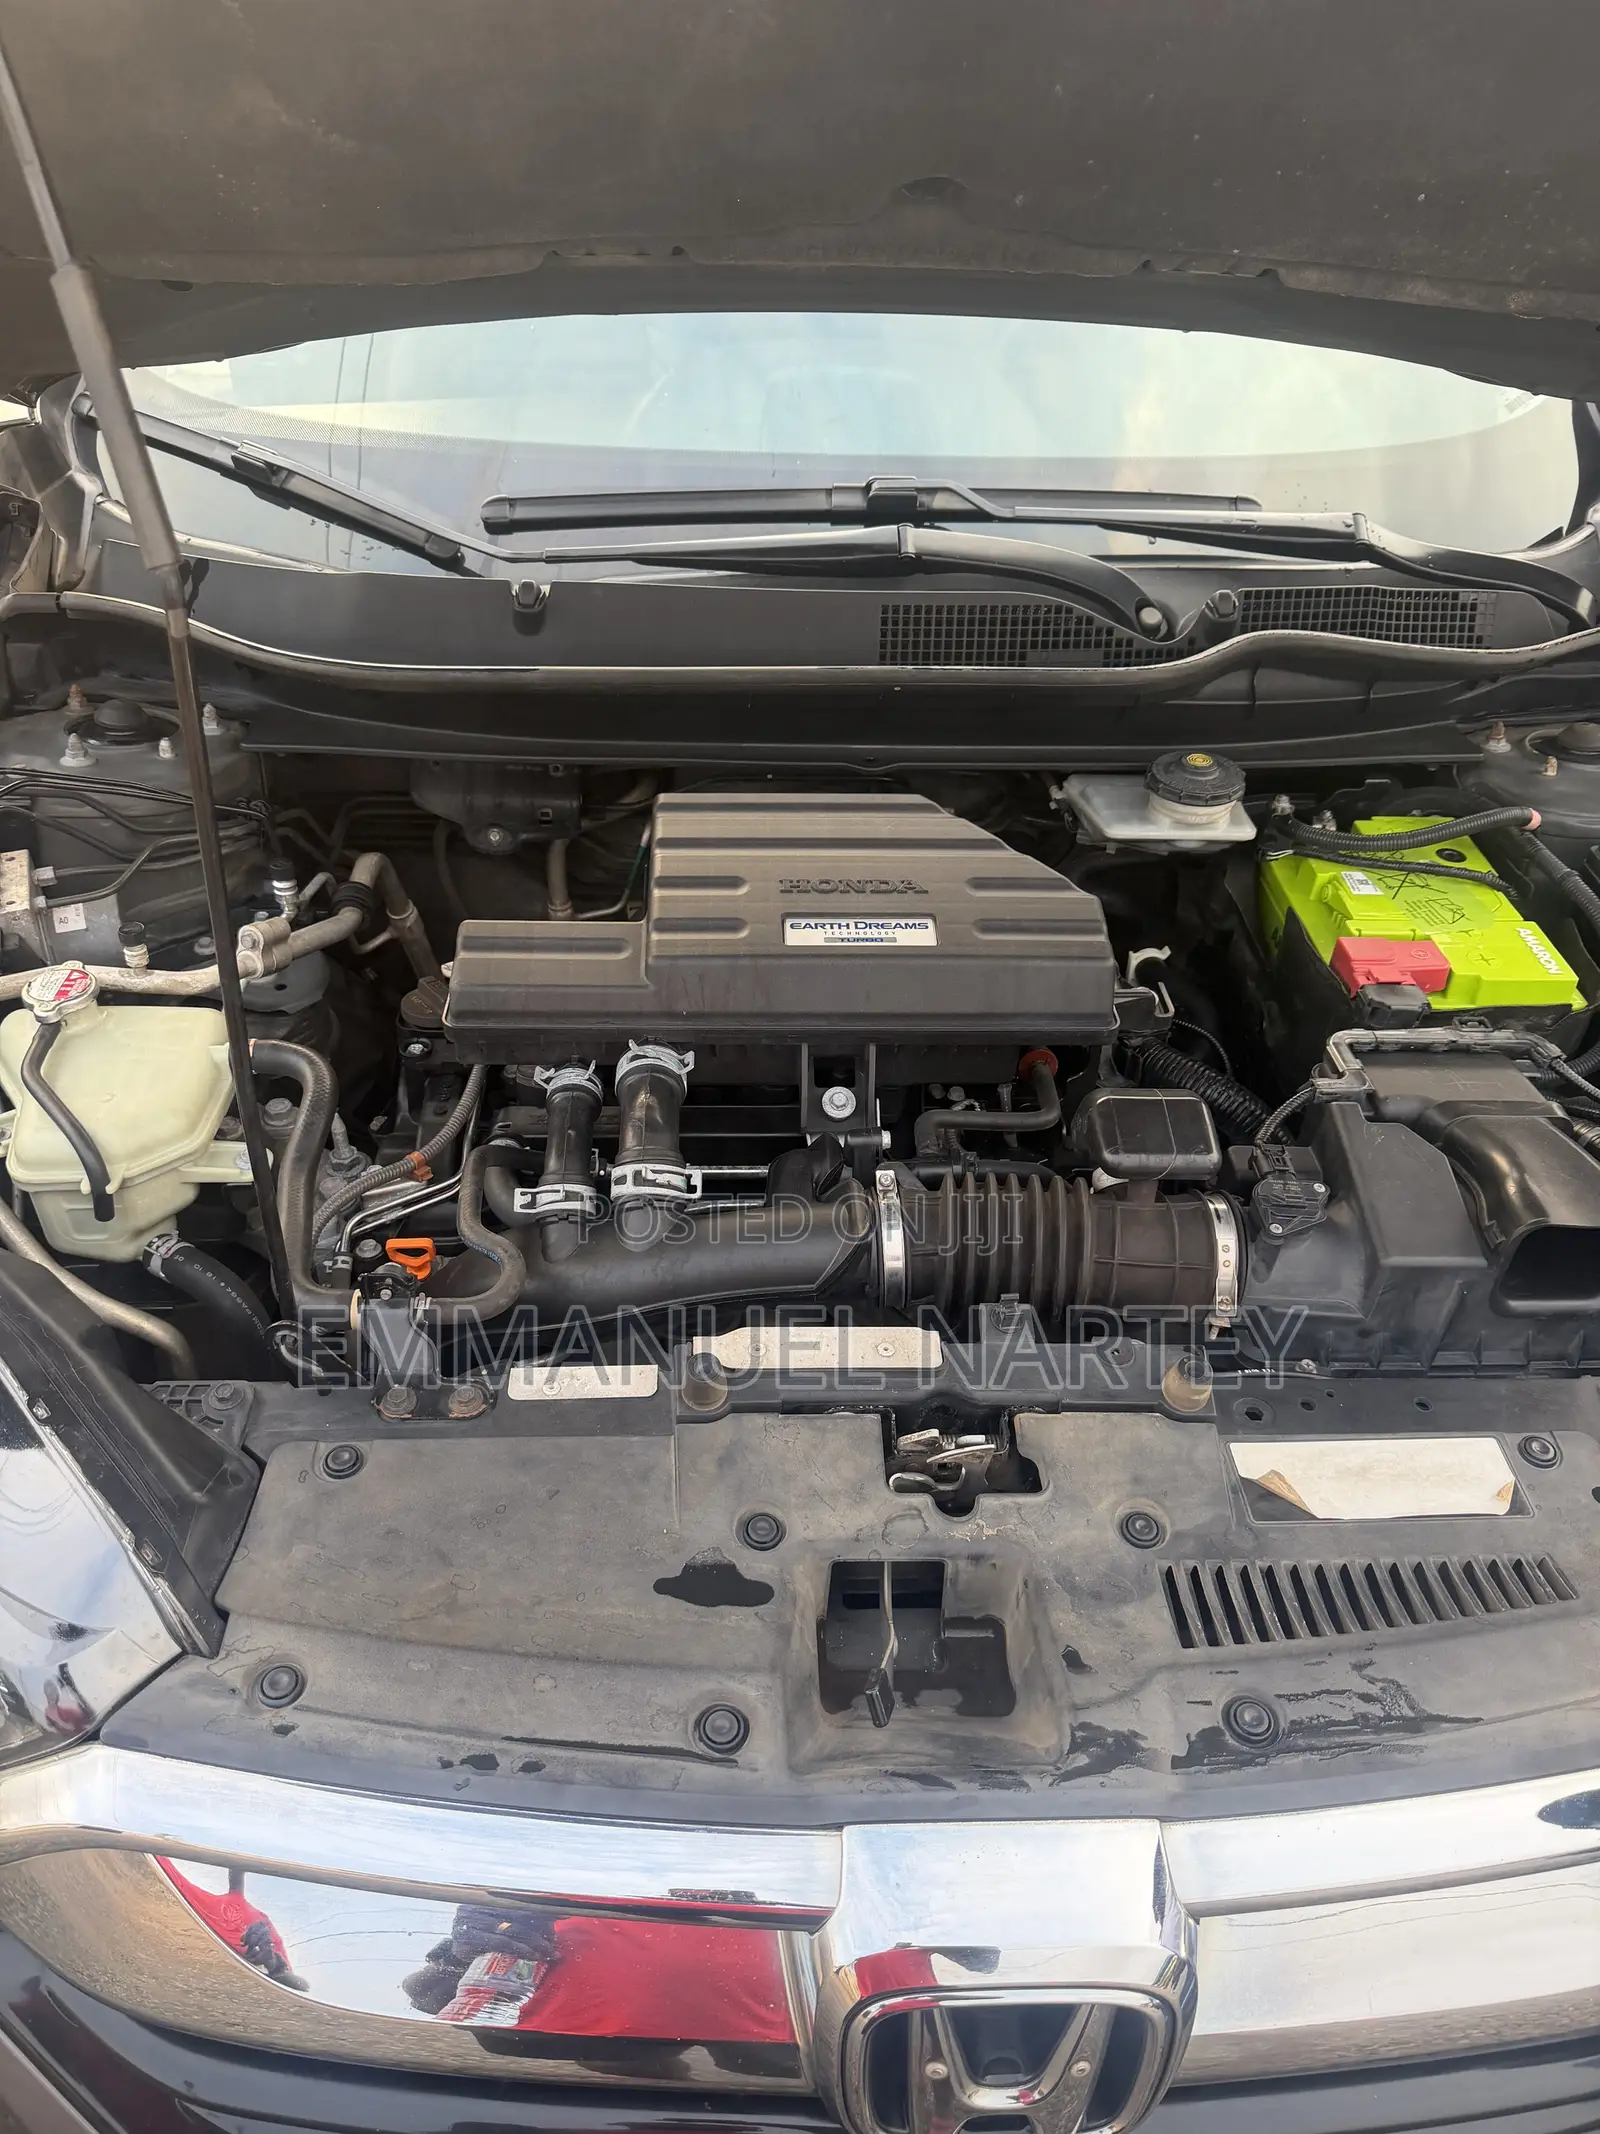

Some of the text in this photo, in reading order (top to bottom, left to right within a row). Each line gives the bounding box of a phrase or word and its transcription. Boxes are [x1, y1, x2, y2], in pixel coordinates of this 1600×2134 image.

[779, 879, 929, 894] HONDA
[789, 921, 929, 930] EARTH DREAMS
[1515, 927, 1564, 975] AMARON
